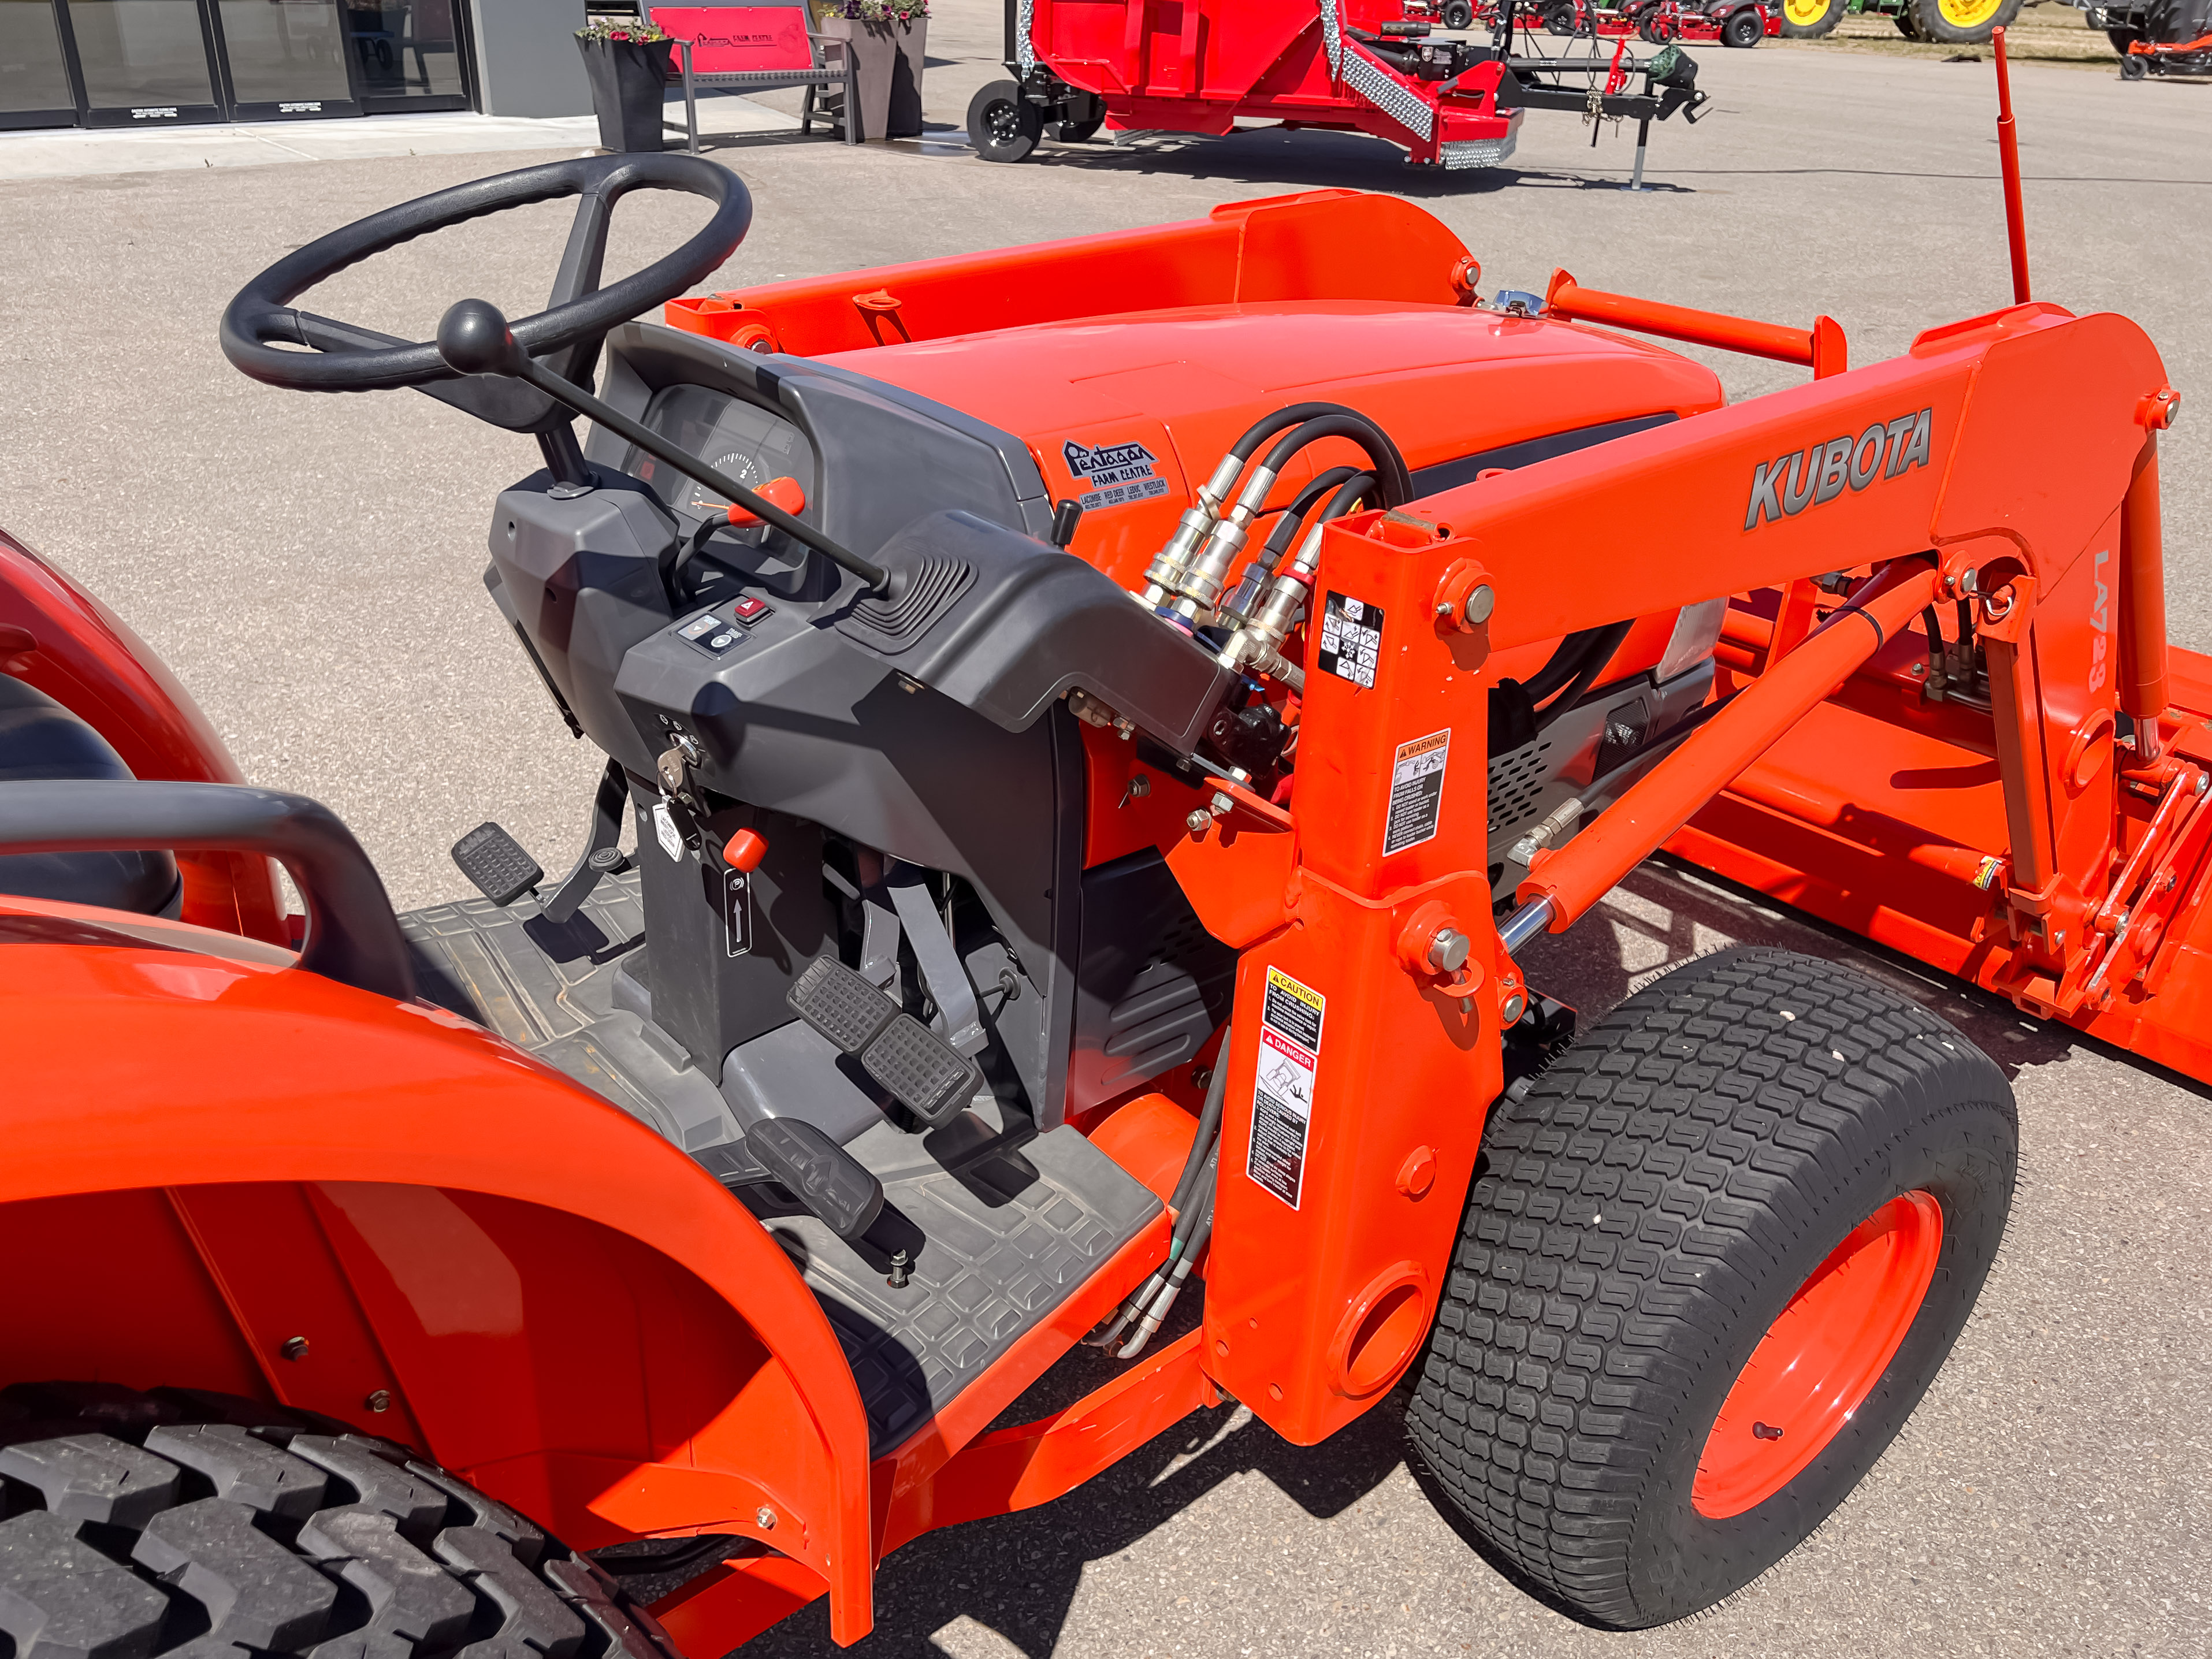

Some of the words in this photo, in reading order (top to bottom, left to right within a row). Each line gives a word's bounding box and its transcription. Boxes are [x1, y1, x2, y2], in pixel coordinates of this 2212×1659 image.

[1064, 441, 1155, 477] Pentagon
[1743, 407, 1932, 531] KUBOTA
[739, 469, 748, 479] 2
[1092, 471, 1119, 486] FARM
[1119, 465, 1153, 481] CENTRE
[1081, 493, 1102, 505] LACOMBE
[1104, 491, 1113, 500] RED
[1113, 488, 1125, 498] DEER
[1127, 485, 1141, 494] LEDUC
[1143, 479, 1166, 491] WESTLOCK
[2088, 550, 2109, 694] LA723
[1408, 734, 1447, 756] WARNING
[1269, 990, 1284, 1003] FROM
[1285, 999, 1315, 1020] CRUSHING:
[1270, 984, 1277, 992] TO
[1280, 990, 1297, 1003] AVOID
[1300, 1001, 1319, 1016] INJURY
[1281, 977, 1319, 1007] CAUTION
[1274, 1039, 1311, 1068] DANGER
[1263, 1098, 1276, 1110] DEATH
